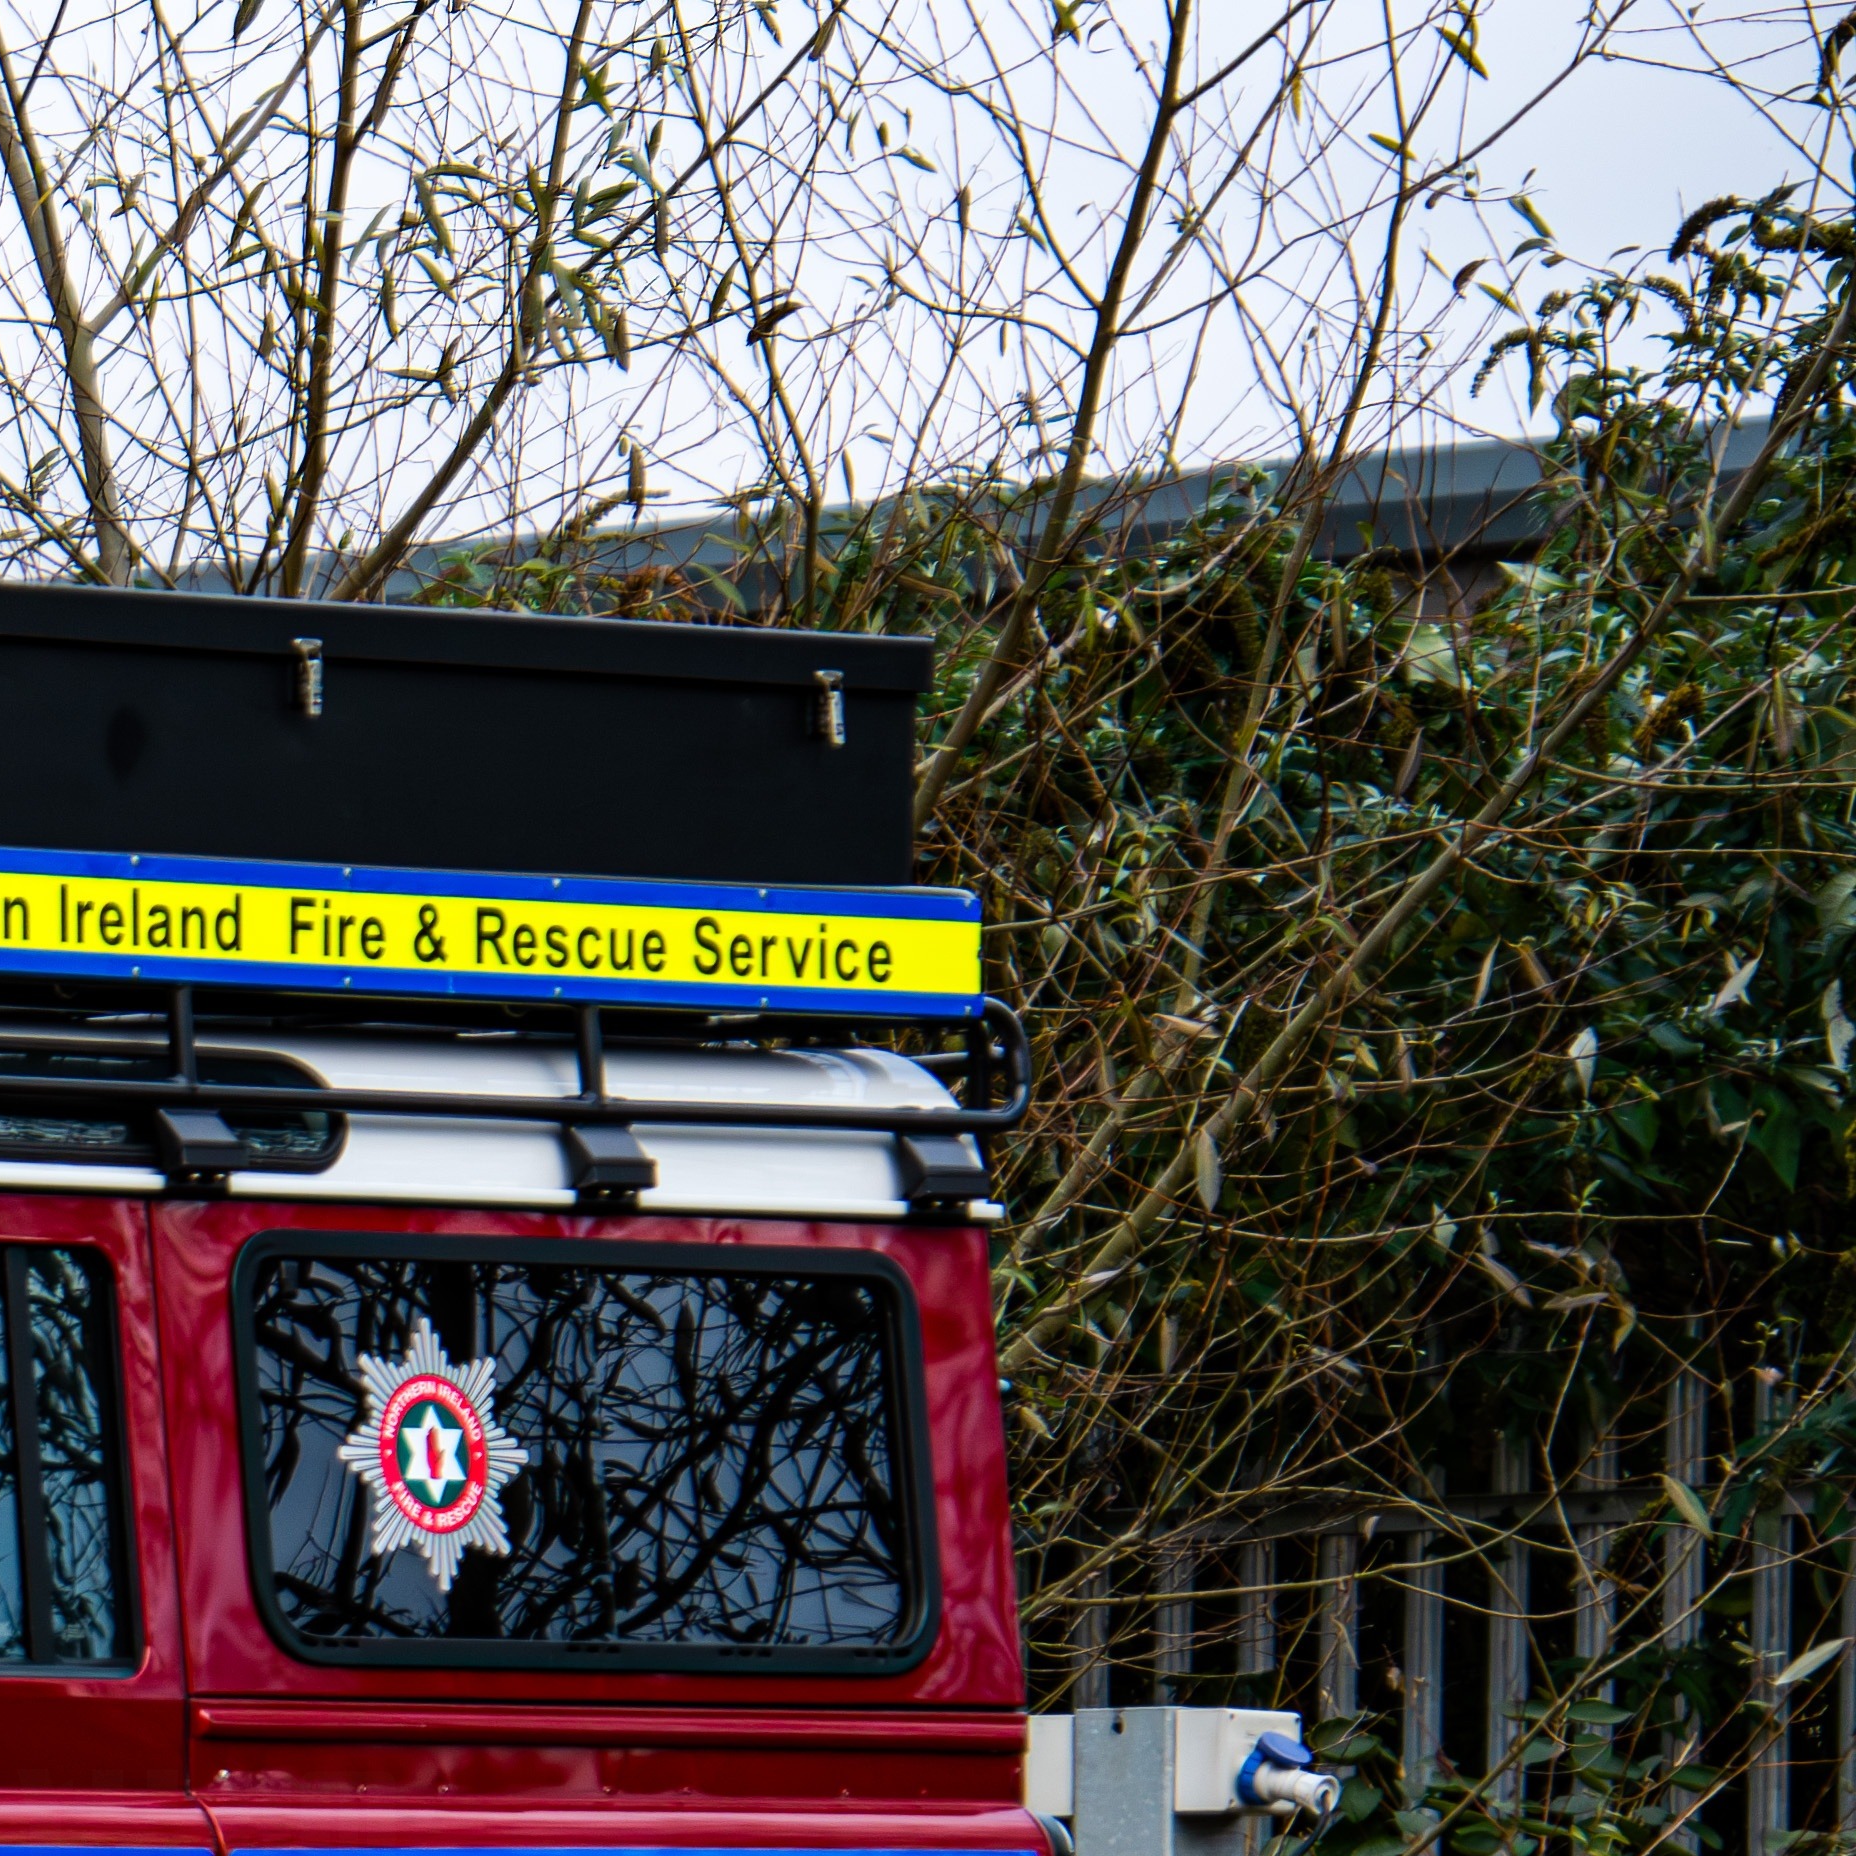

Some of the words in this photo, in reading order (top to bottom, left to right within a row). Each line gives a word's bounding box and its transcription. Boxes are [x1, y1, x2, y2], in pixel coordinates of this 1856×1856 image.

[59, 883, 242, 953] Ireland
[289, 896, 386, 960] Fire
[413, 903, 447, 963] &
[475, 906, 666, 973] Rescue
[692, 916, 893, 984] Service
[384, 1380, 437, 1438] NORTHERN
[437, 1384, 482, 1441] IRELAND
[437, 1480, 483, 1527] RESCUE
